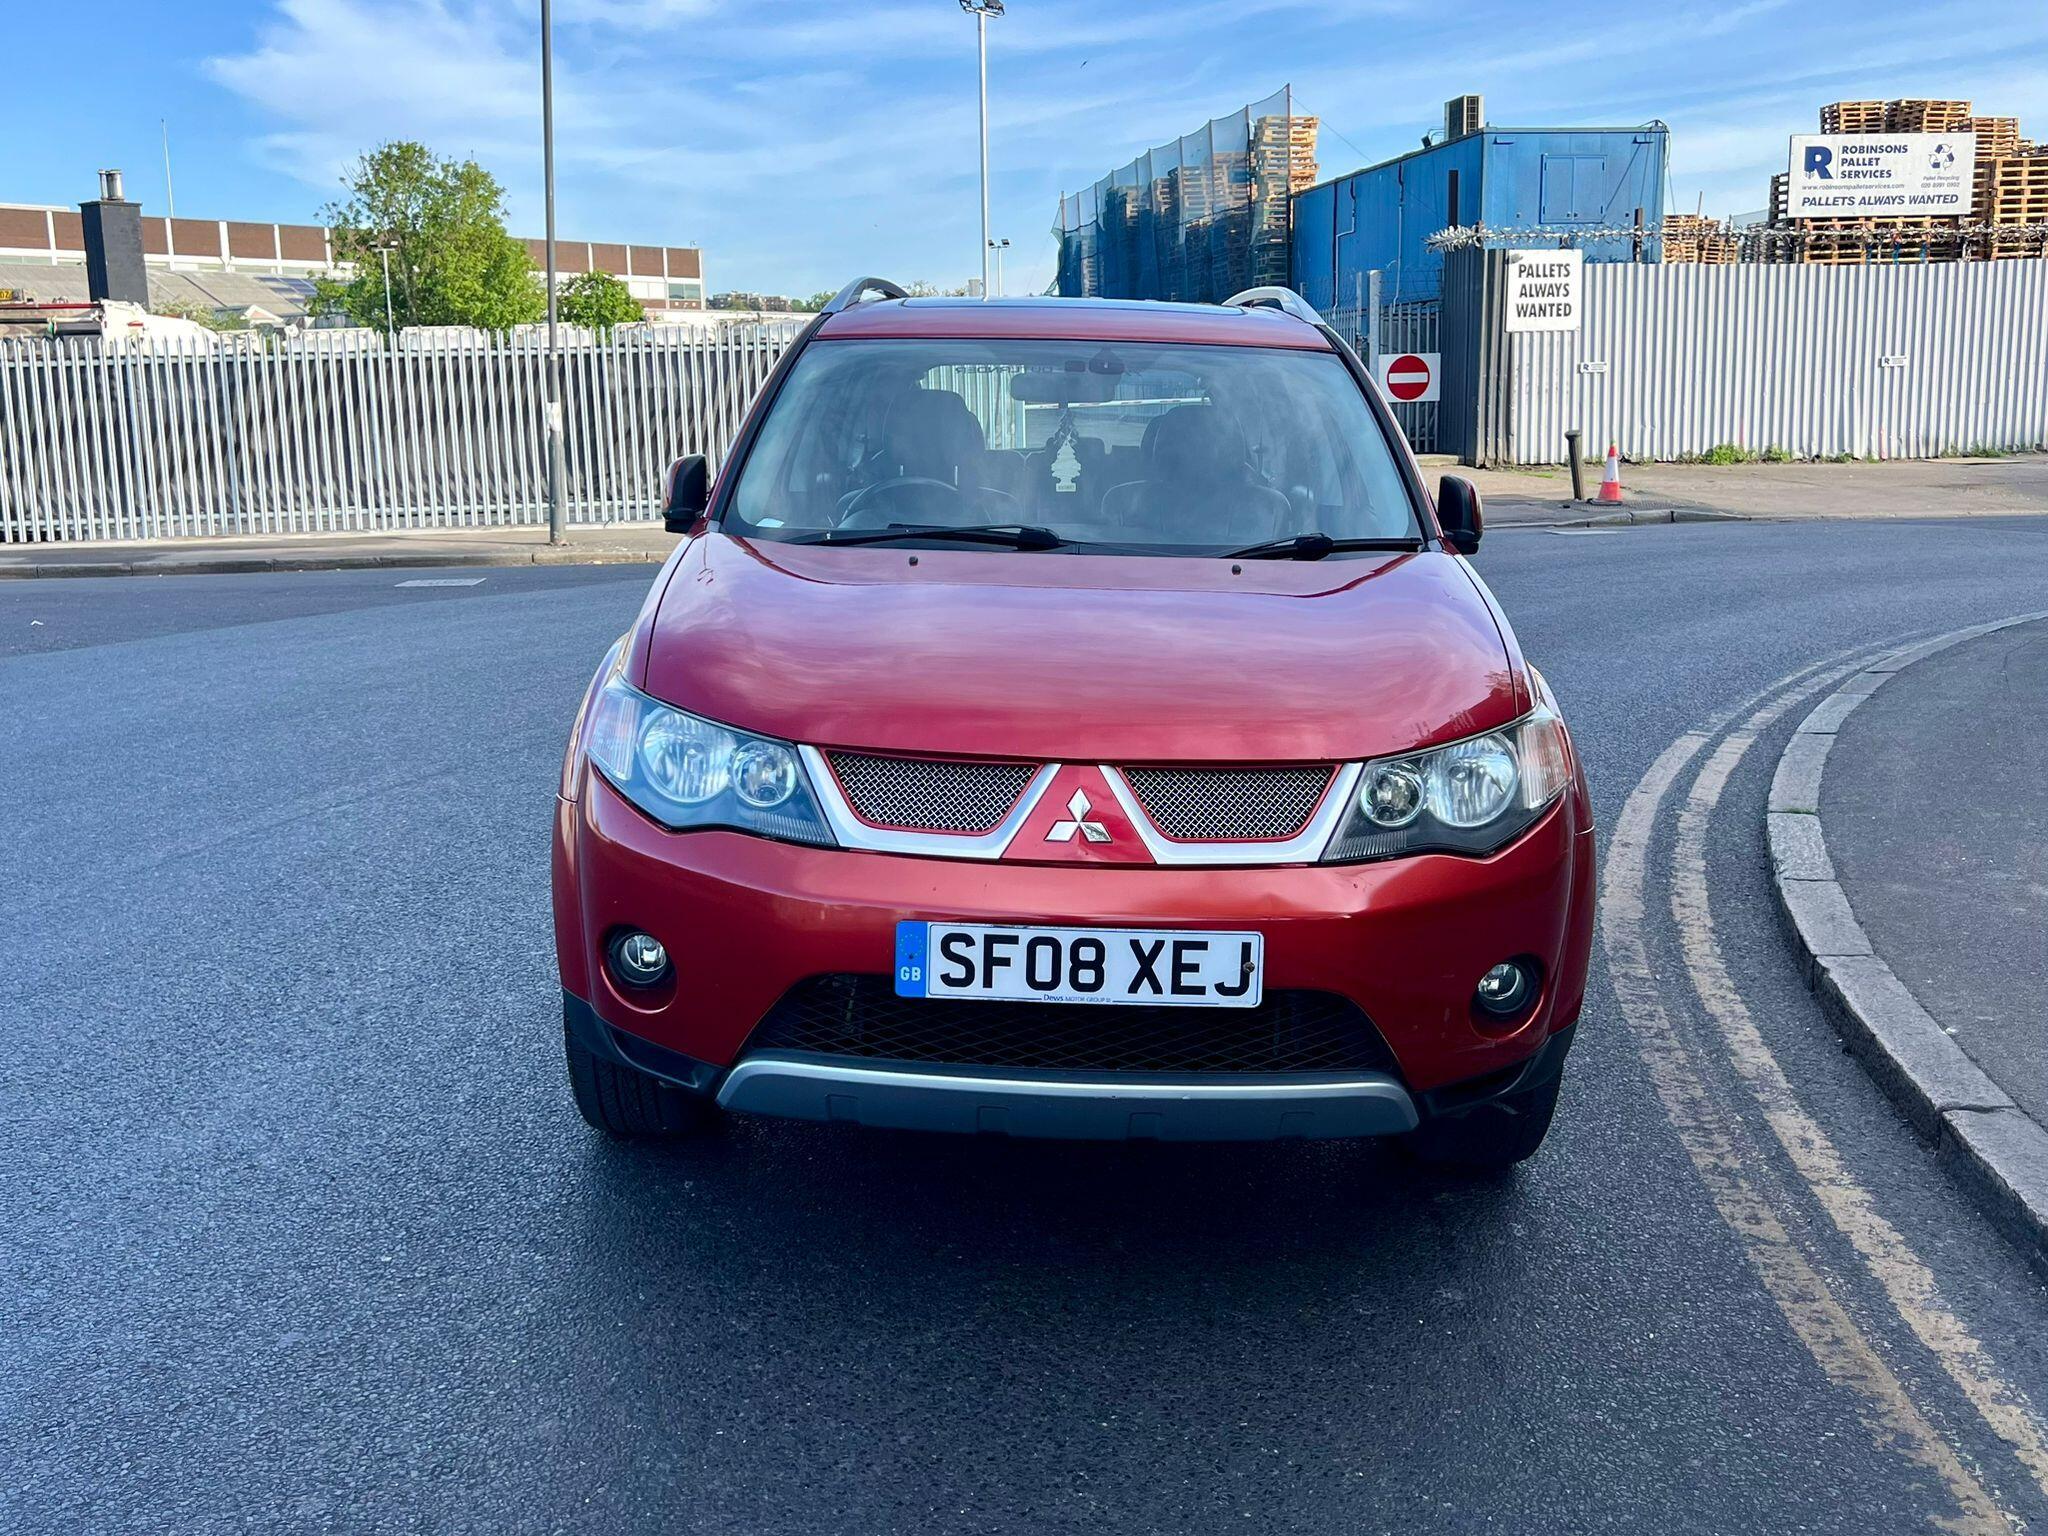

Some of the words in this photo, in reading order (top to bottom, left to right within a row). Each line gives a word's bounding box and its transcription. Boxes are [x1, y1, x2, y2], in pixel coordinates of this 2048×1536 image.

[1841, 144, 1908, 154] ROBINSONS
[1804, 146, 1833, 179] R
[1840, 157, 1880, 167] PALLET
[1840, 169, 1892, 179] SERVICES
[1801, 196, 1855, 207] PALLETS
[1858, 195, 1905, 206] ALWAYS
[1908, 194, 1959, 205] WANTED
[1518, 263, 1570, 278] PALLETS
[1519, 283, 1570, 298] ALWAYS
[1516, 303, 1572, 318] WANTED
[940, 932, 1106, 993] SF08
[1127, 938, 1254, 997] XEJ
[900, 967, 921, 982] GB
[1043, 994, 1064, 1002] Dews
